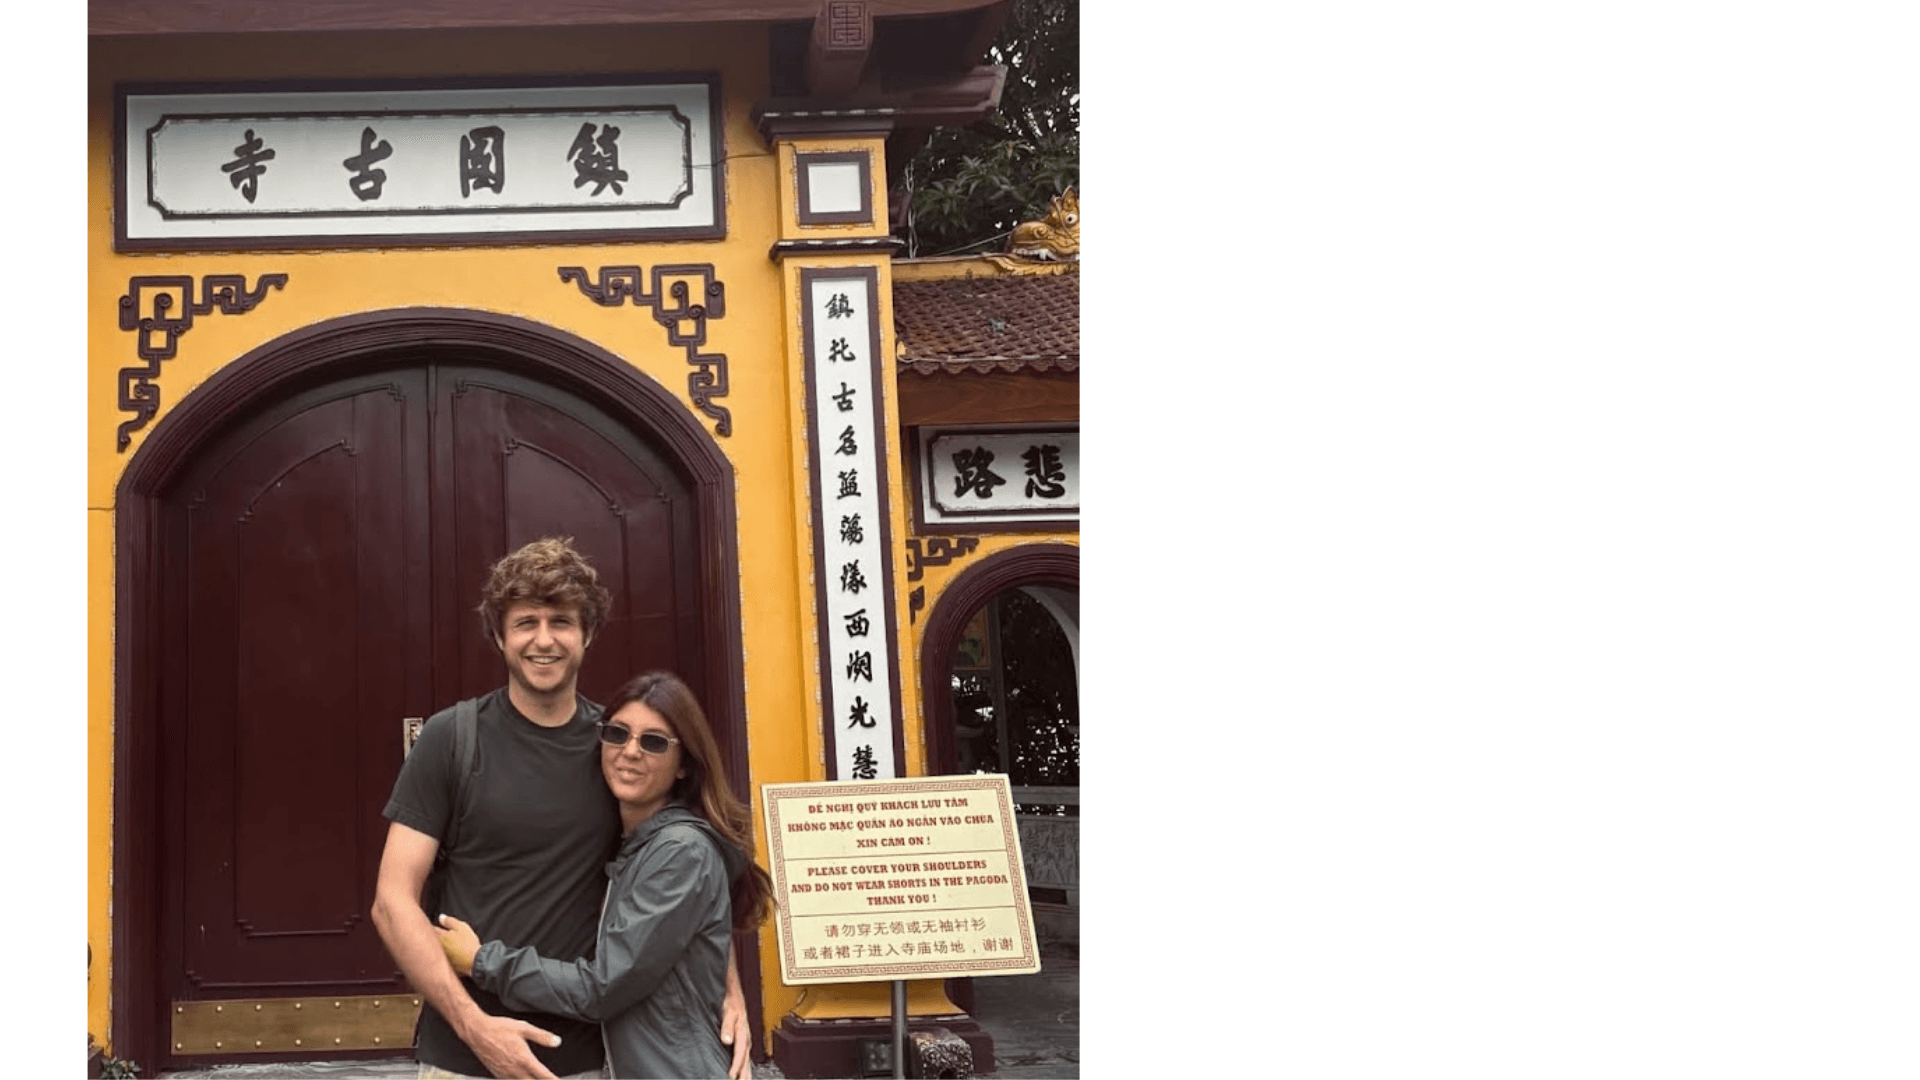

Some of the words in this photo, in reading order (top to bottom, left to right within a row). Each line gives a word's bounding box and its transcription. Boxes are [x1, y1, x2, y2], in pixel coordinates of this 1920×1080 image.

[857, 838, 877, 849] XIN
[807, 865, 848, 877] PLEASE
[851, 864, 888, 875] COVER
[891, 863, 921, 874] YOUR
[923, 859, 987, 872] SHOULDERS
[791, 883, 812, 894] AND
[815, 882, 830, 893] DO
[833, 881, 852, 892] NOT
[856, 879, 885, 891] WEAR
[888, 877, 926, 890] SHORTS
[929, 877, 940, 888] IN
[943, 876, 963, 887] THE
[966, 874, 1008, 886] PAGODA
[867, 895, 905, 907] THANK
[908, 894, 929, 905] YOU
[825, 918, 985, 937] 请勿穿无领或无袖衬衫
